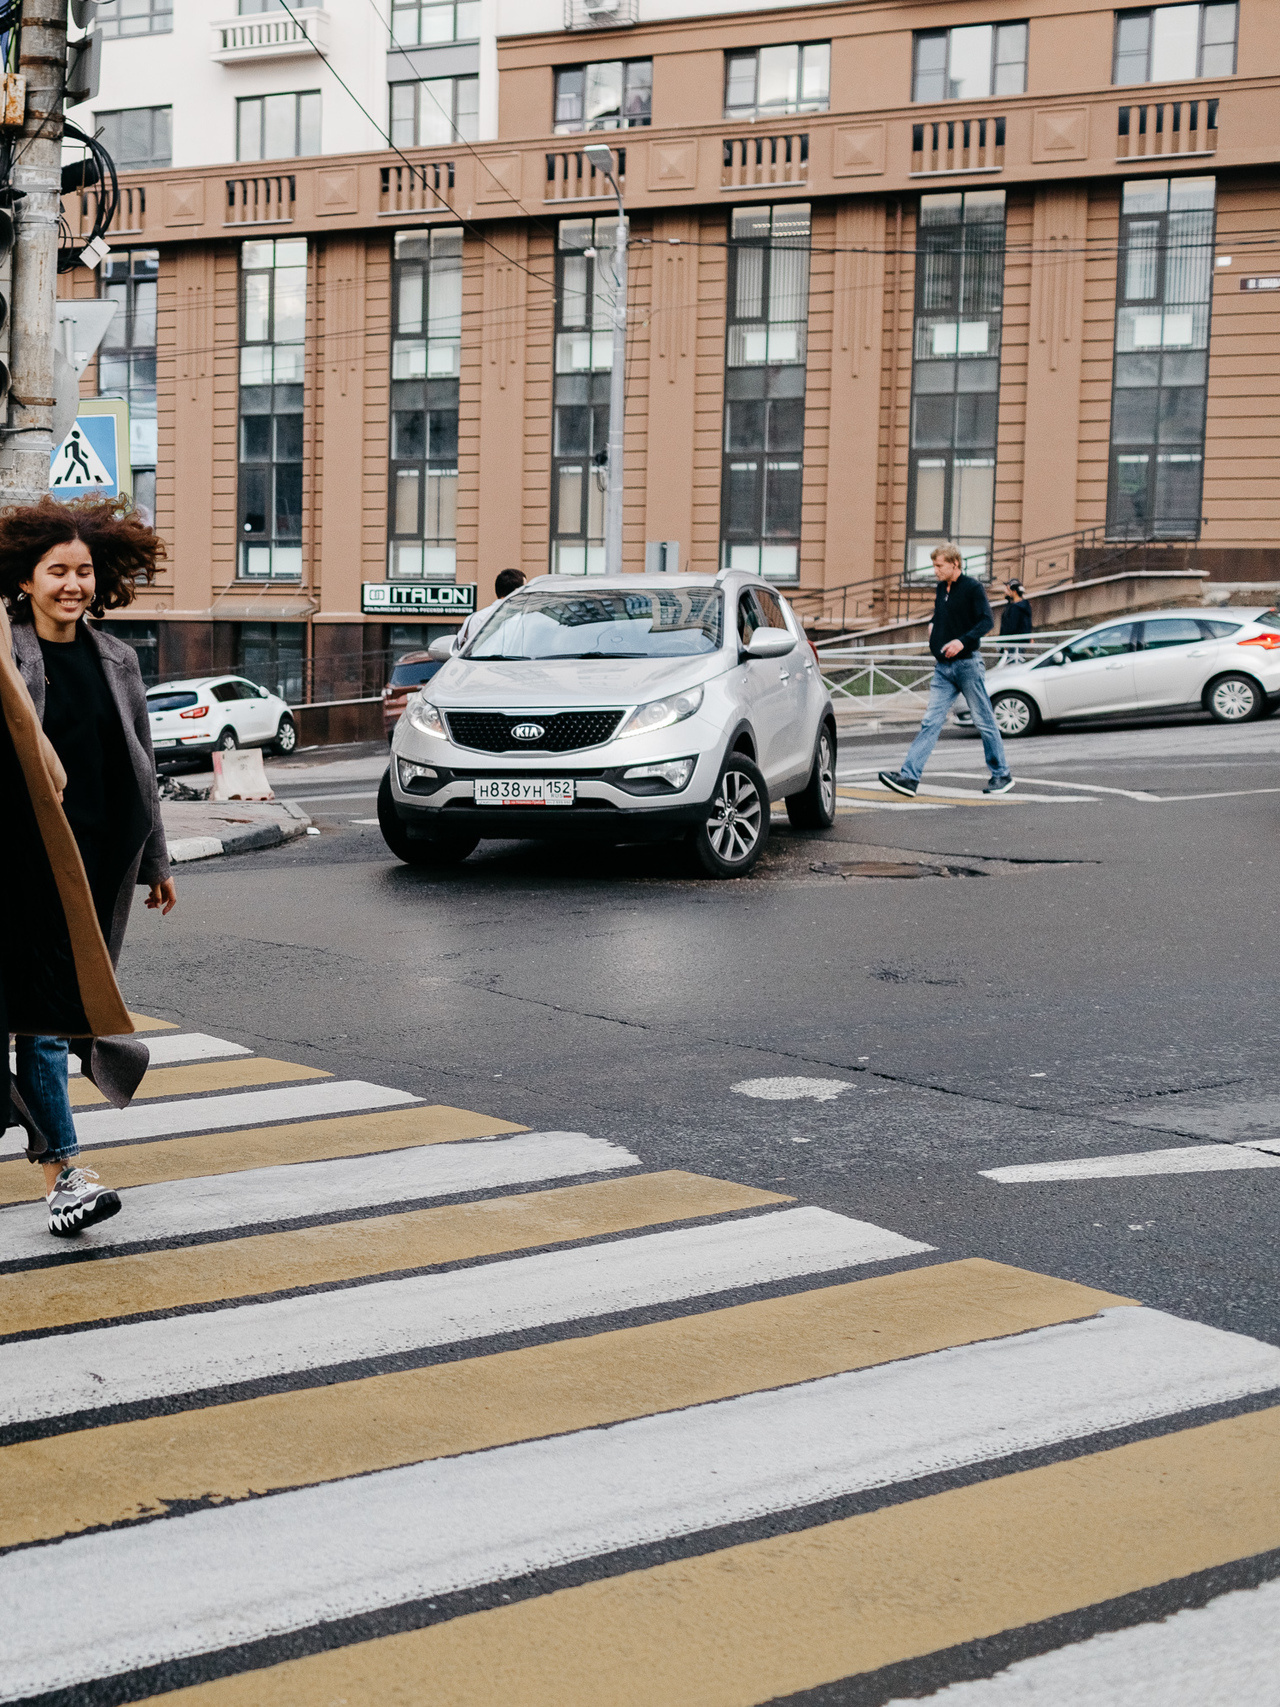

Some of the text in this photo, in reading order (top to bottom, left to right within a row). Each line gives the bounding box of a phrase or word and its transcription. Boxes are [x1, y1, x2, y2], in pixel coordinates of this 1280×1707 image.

[392, 587, 468, 604] ITALON
[515, 726, 539, 738] KIA
[480, 781, 570, 798] Н838УН 152
